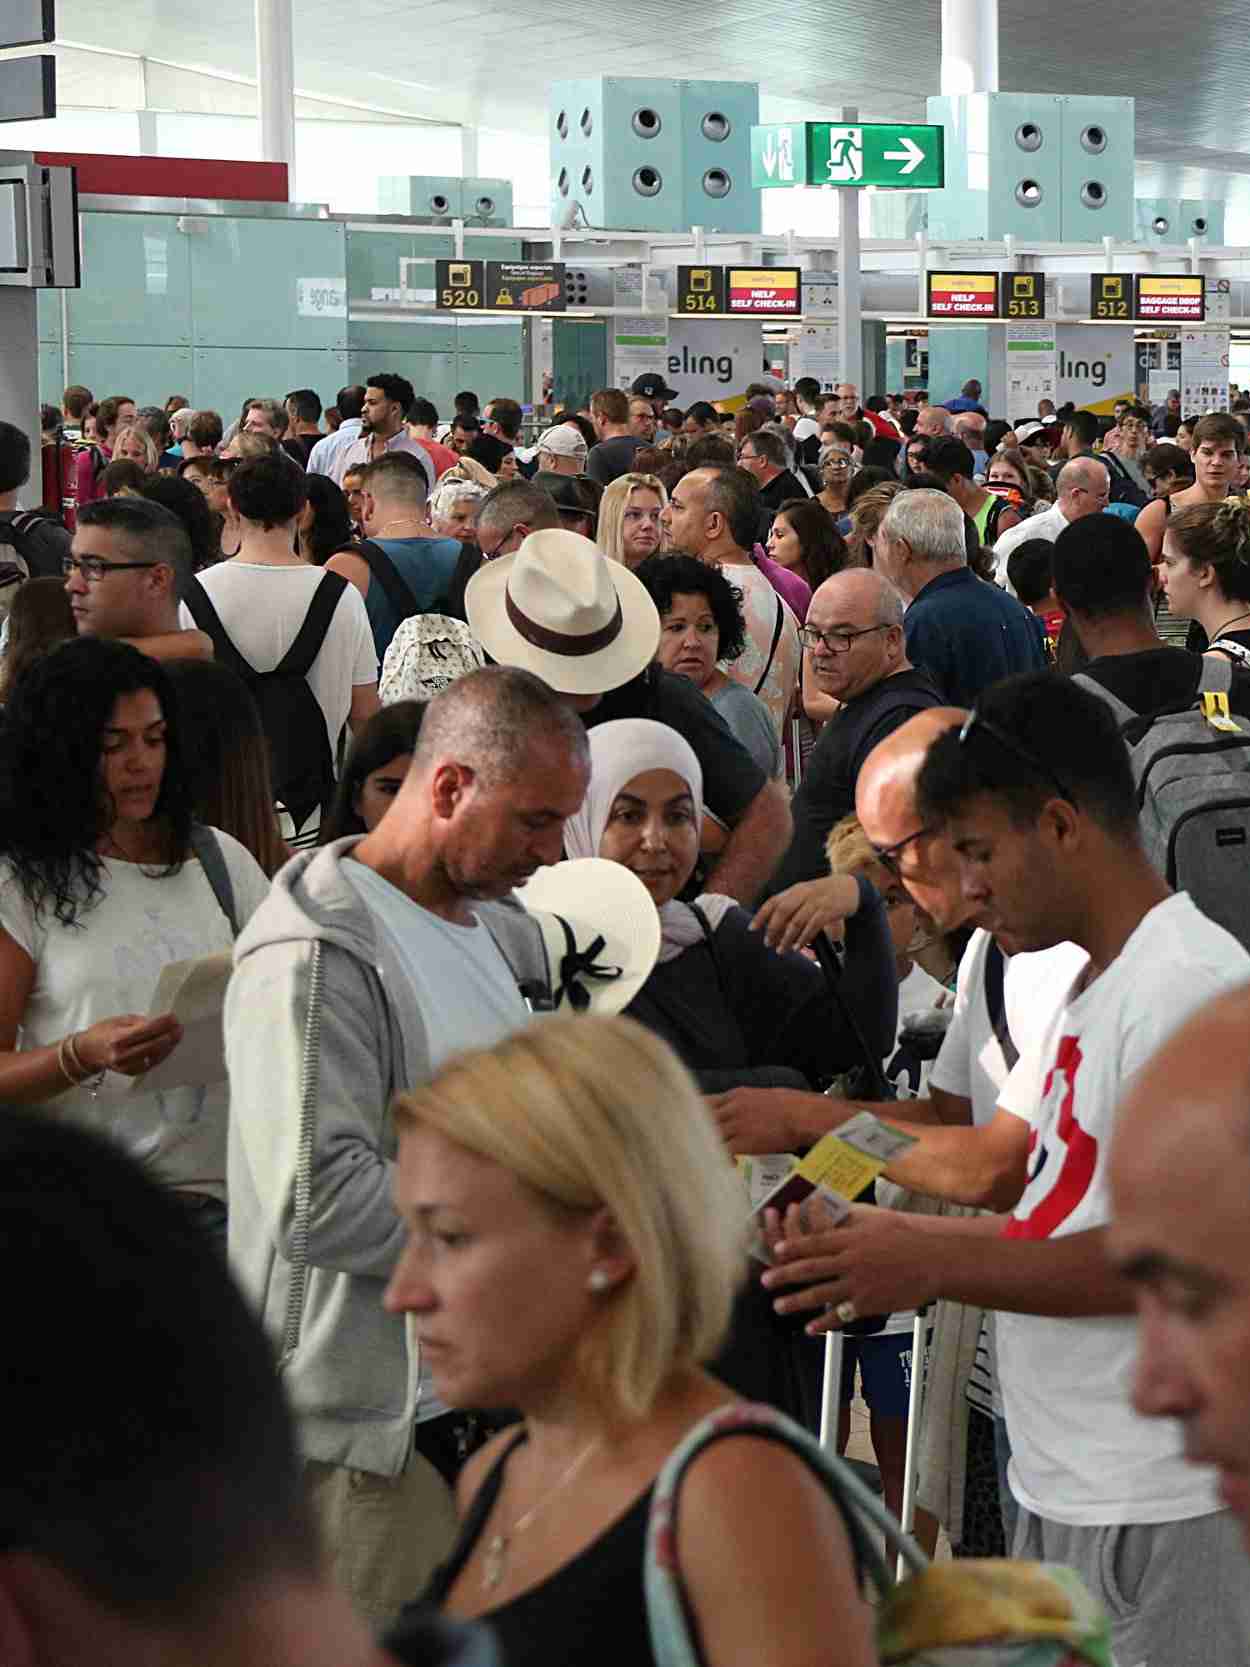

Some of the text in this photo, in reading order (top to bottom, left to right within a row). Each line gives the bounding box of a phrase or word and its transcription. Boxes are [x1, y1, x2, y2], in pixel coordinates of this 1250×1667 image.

[441, 290, 479, 306] 520
[751, 290, 777, 299] HELP
[950, 294, 977, 302] HELP
[685, 295, 717, 311] 514
[730, 299, 797, 308] SELF CHECK-IN
[1139, 297, 1179, 305] BAGGAGE
[931, 303, 995, 312] SELF CHECK-IN
[1008, 301, 1040, 315] 513
[1096, 301, 1129, 317] 512
[1139, 306, 1201, 314] SELF CHECK-IN
[1056, 351, 1107, 387] ling
